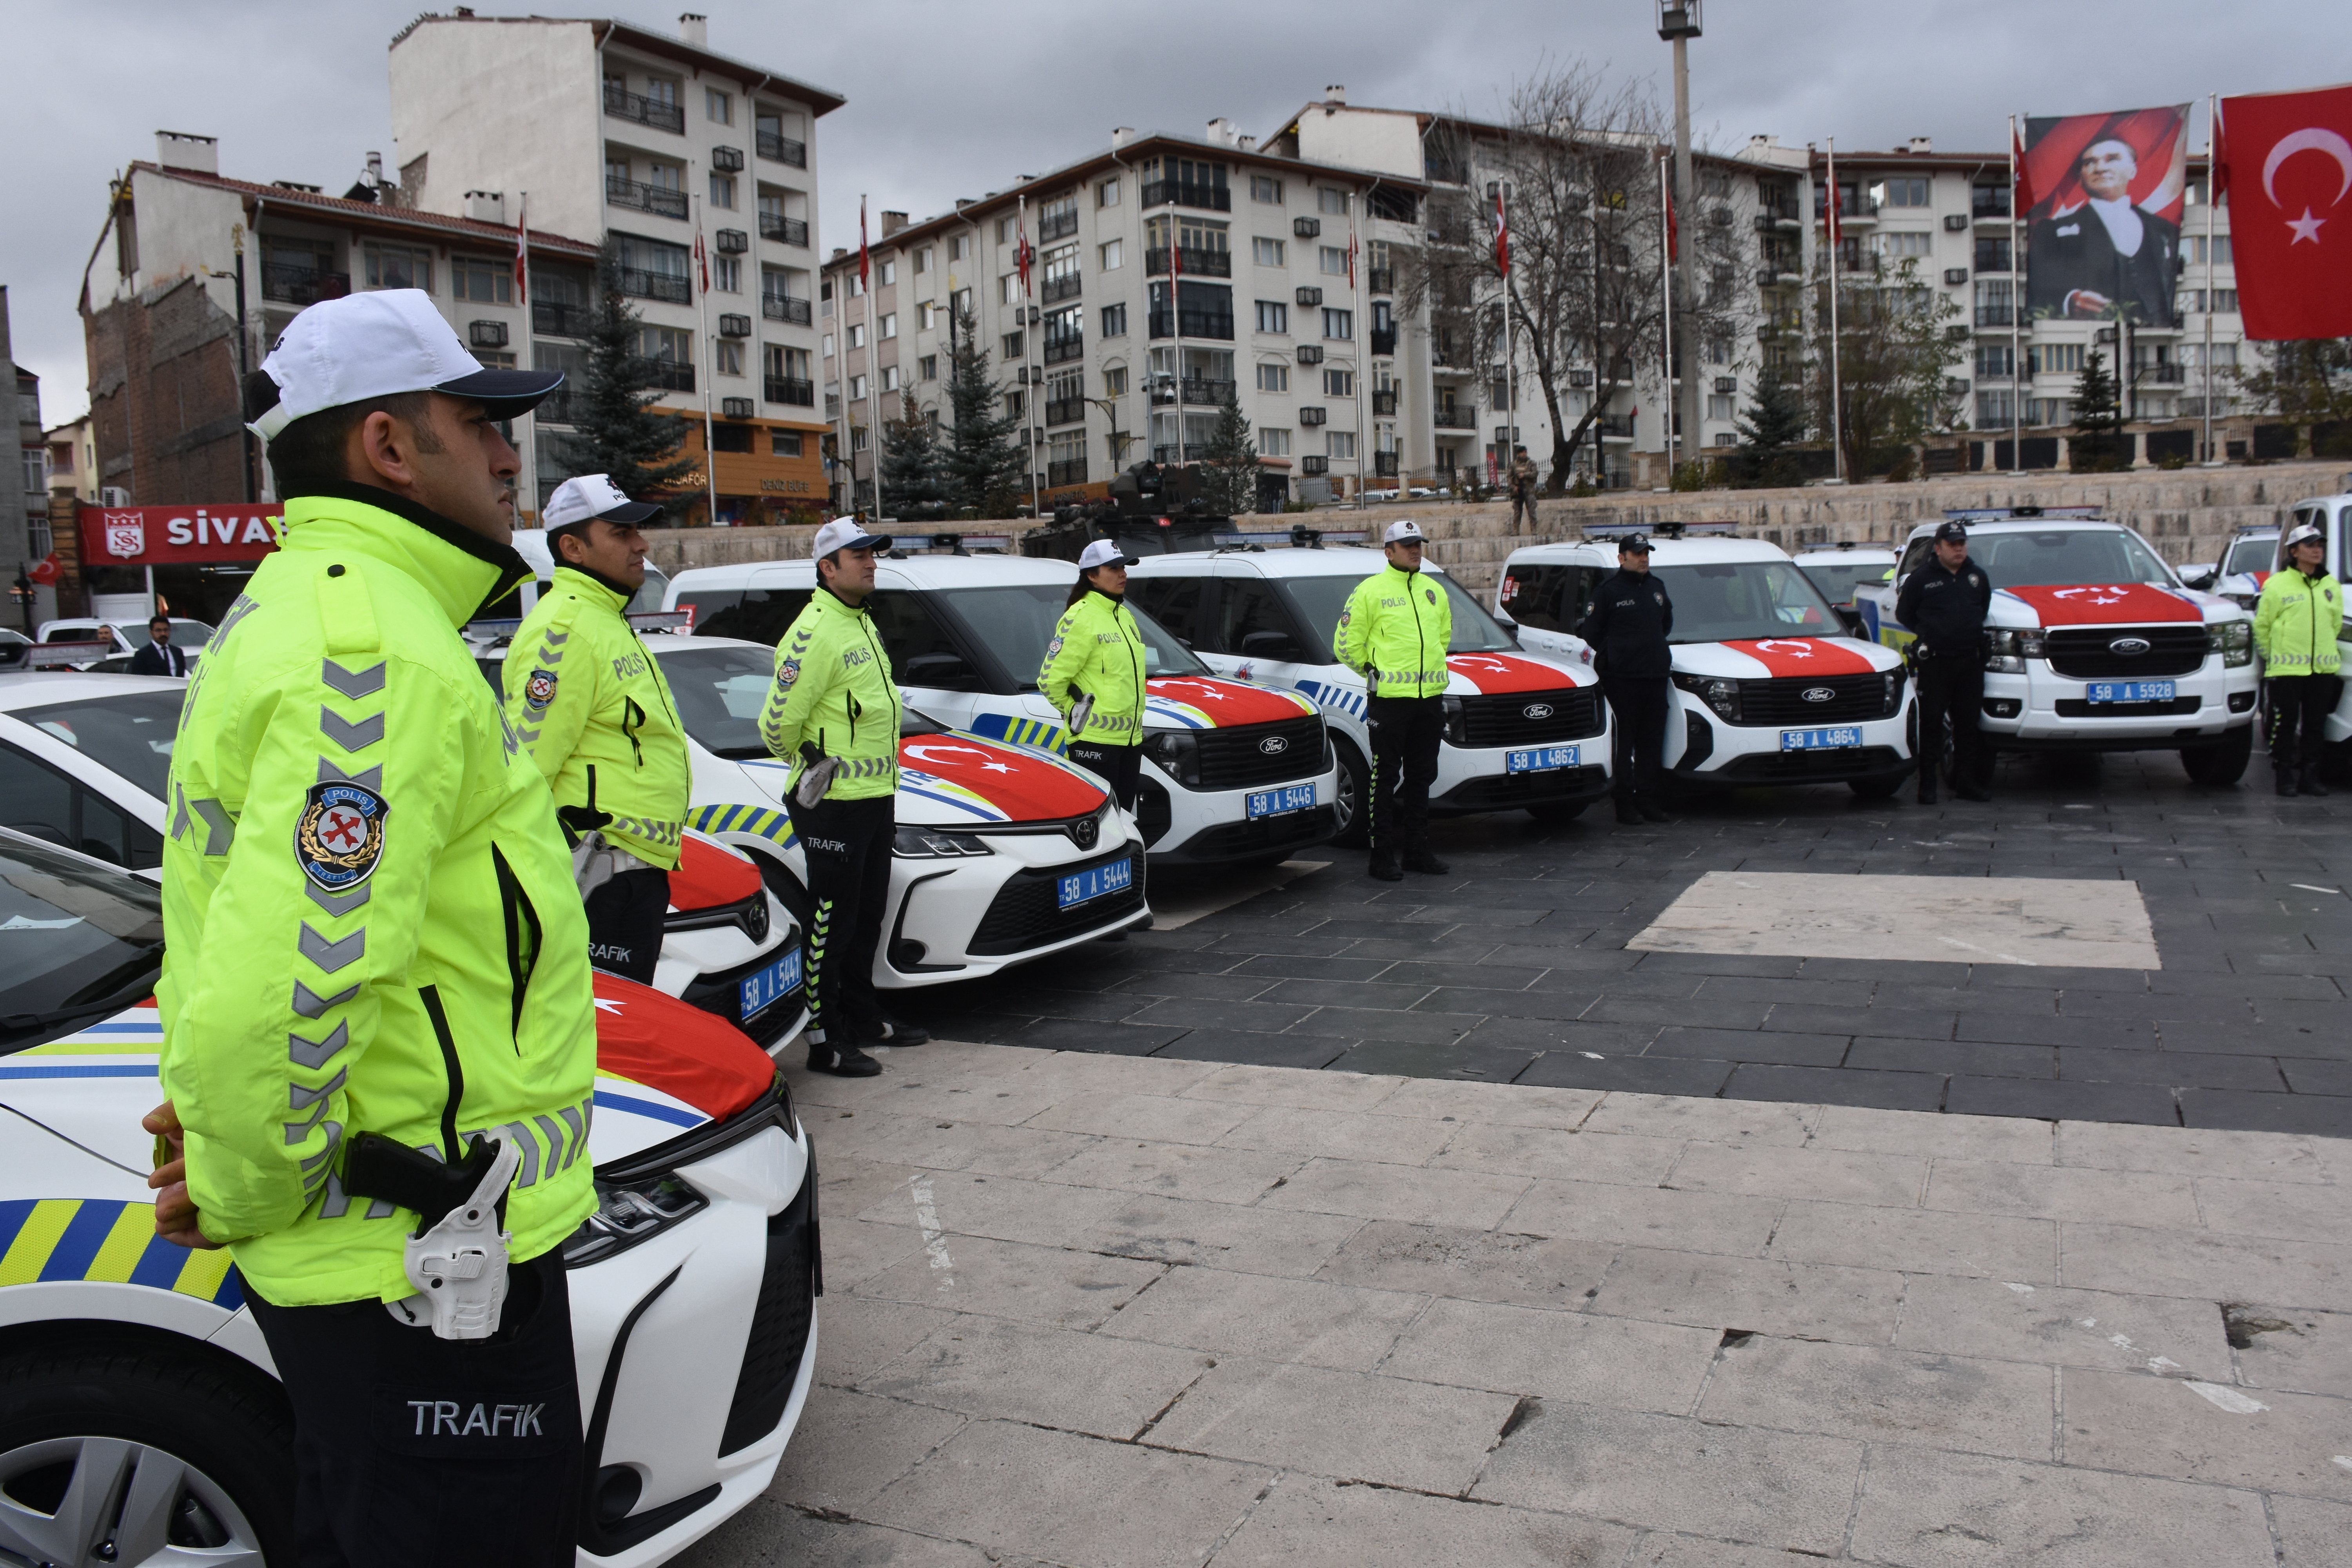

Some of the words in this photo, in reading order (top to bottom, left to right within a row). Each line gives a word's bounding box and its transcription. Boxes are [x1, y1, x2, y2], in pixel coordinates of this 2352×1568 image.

[1381, 597, 1406, 609] POLİS
[1097, 632, 1122, 644] POLİS
[612, 652, 646, 681] POLİS
[844, 647, 871, 669] POLİS
[1808, 690, 1829, 699] Ford
[2096, 685, 2112, 700] 58
[2124, 684, 2132, 699] A
[2140, 683, 2172, 698] 5928
[1530, 706, 1548, 717] Ford
[1265, 739, 1283, 751] Ford
[1788, 732, 1804, 748] 58
[1812, 731, 1819, 746] A
[1826, 729, 1856, 745] 4864
[1514, 753, 1528, 769] 58
[1535, 752, 1542, 767] A
[1548, 748, 1575, 765] 4862
[333, 789, 368, 804] POLİS
[1254, 795, 1267, 814] 58
[1274, 792, 1280, 810] A
[1286, 787, 1311, 808] 5446
[808, 837, 846, 852] TRAFİK
[1065, 877, 1080, 902] 58
[1091, 872, 1097, 894] A
[1104, 862, 1129, 889] 5444
[588, 942, 632, 963] RAFİK
[746, 978, 759, 1011] 58
[768, 969, 774, 998] A
[779, 953, 799, 991] 5441
[407, 1401, 546, 1437] TRAFİK
